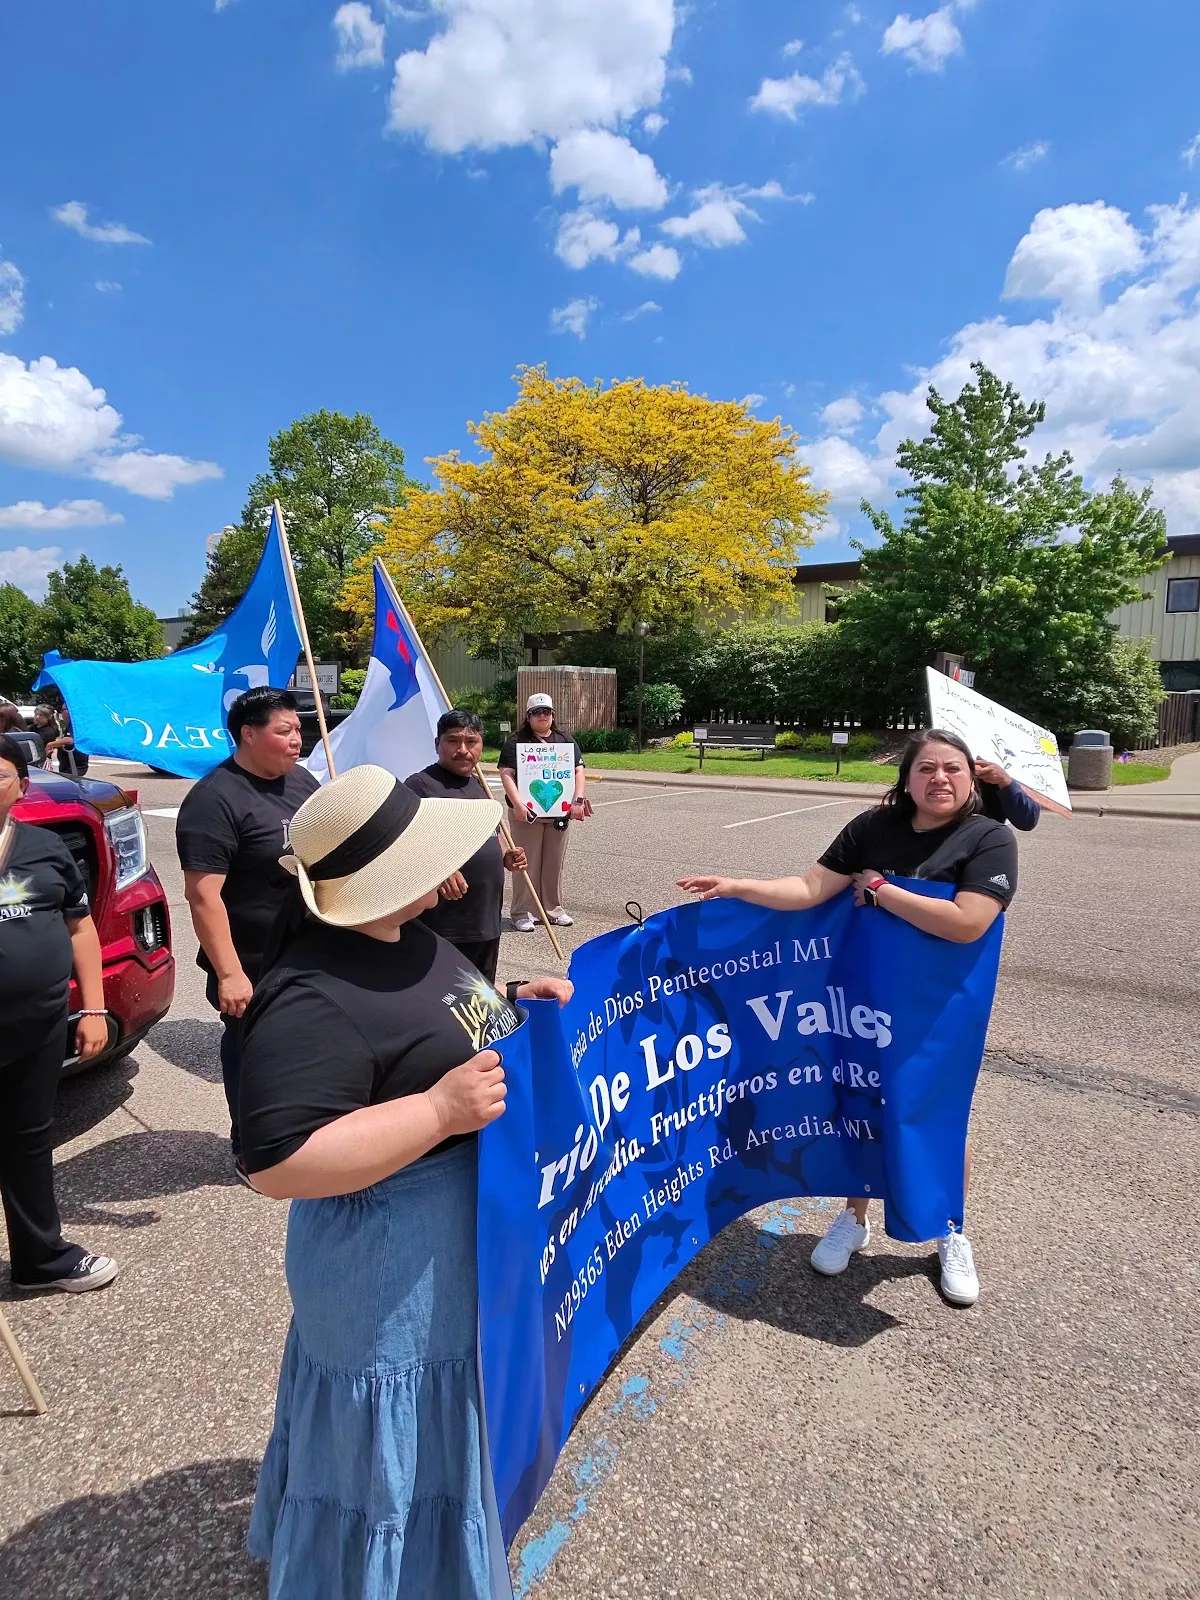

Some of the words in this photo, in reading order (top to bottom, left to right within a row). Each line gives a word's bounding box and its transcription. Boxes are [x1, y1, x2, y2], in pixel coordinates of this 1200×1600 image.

[536, 746, 548, 754] que
[542, 768, 572, 780] Dios
[0, 903, 32, 920] ADIA
[441, 992, 458, 1006] UNA
[570, 1028, 588, 1070] lesia
[588, 1011, 603, 1042] de
[604, 990, 644, 1028] Dios
[648, 941, 783, 1003] Pentecostal
[792, 936, 833, 964] MI
[537, 1123, 599, 1210] rio
[589, 1071, 631, 1143] De
[640, 1022, 732, 1092] Los
[746, 985, 893, 1049] Valles
[560, 1207, 579, 1246] en
[650, 1070, 778, 1147] Fructíferos
[788, 1063, 823, 1086] en
[832, 1059, 845, 1085] el
[554, 1245, 604, 1343] N29365
[604, 1213, 642, 1262] Eden
[642, 1160, 705, 1220] Heights
[708, 1137, 739, 1170] Rd.
[745, 1115, 841, 1151] Arcadia,
